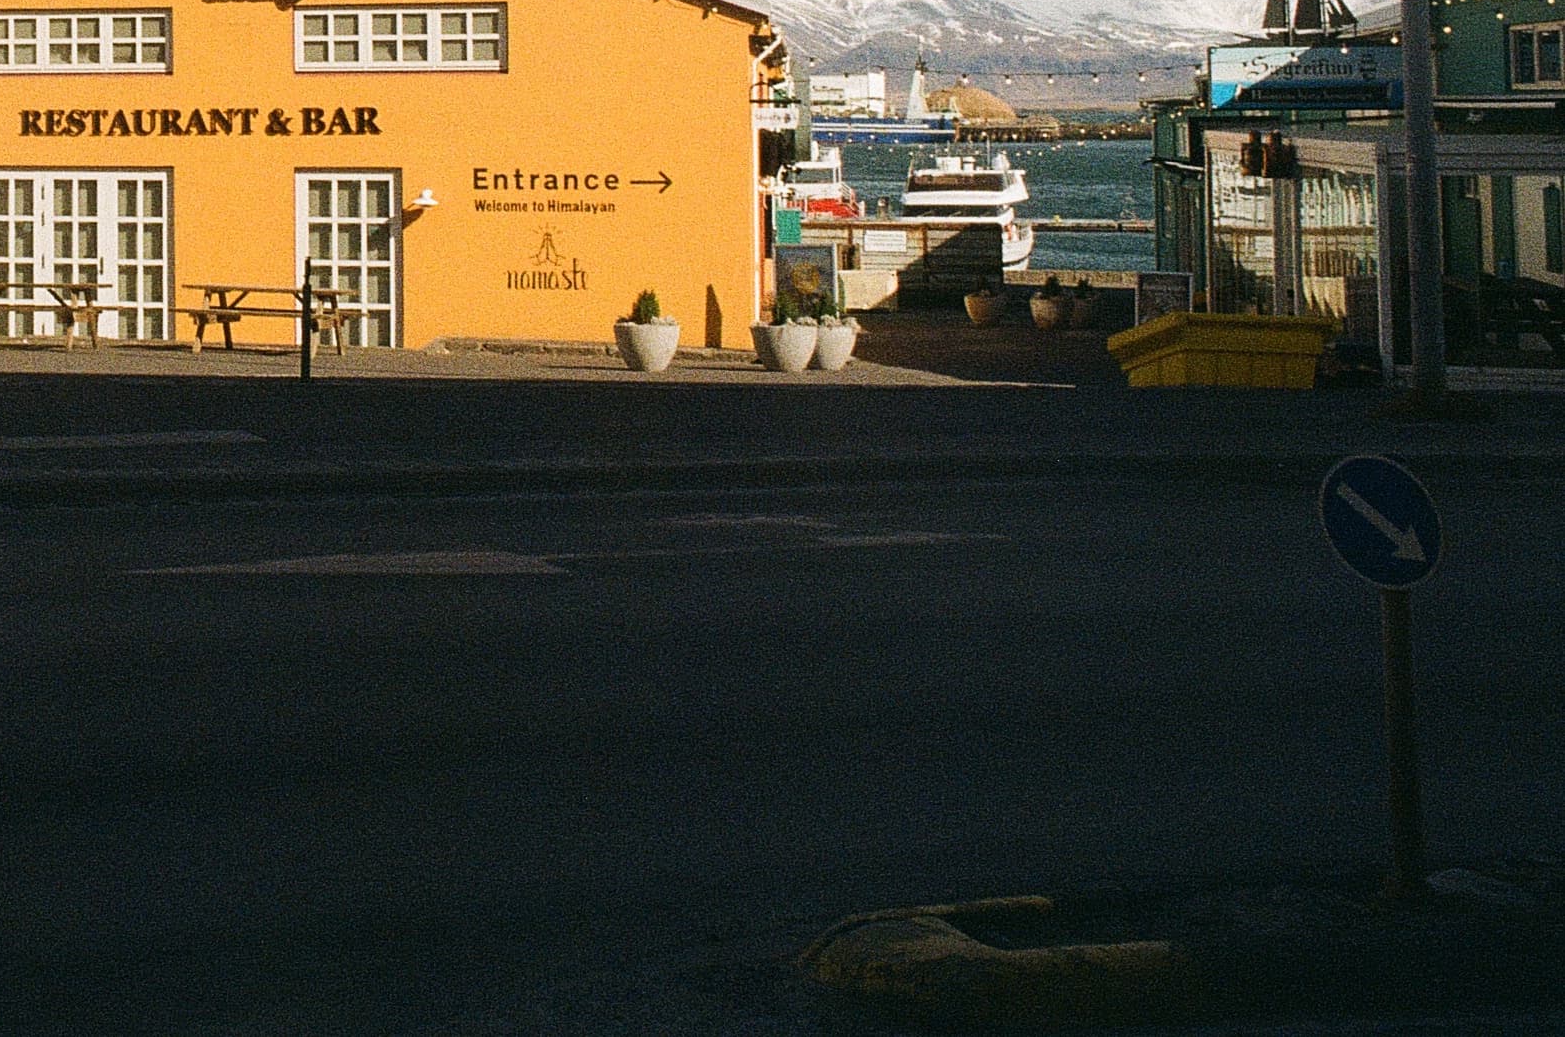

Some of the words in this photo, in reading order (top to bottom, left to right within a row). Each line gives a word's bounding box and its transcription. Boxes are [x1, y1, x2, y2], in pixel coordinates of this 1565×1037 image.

[18, 108, 259, 137] RESTAURANT
[264, 107, 293, 137] &
[299, 106, 383, 136] BAR
[473, 168, 620, 191] Entrance
[474, 199, 528, 212] Welcome
[533, 201, 545, 212] to
[547, 199, 616, 214] Himalayan
